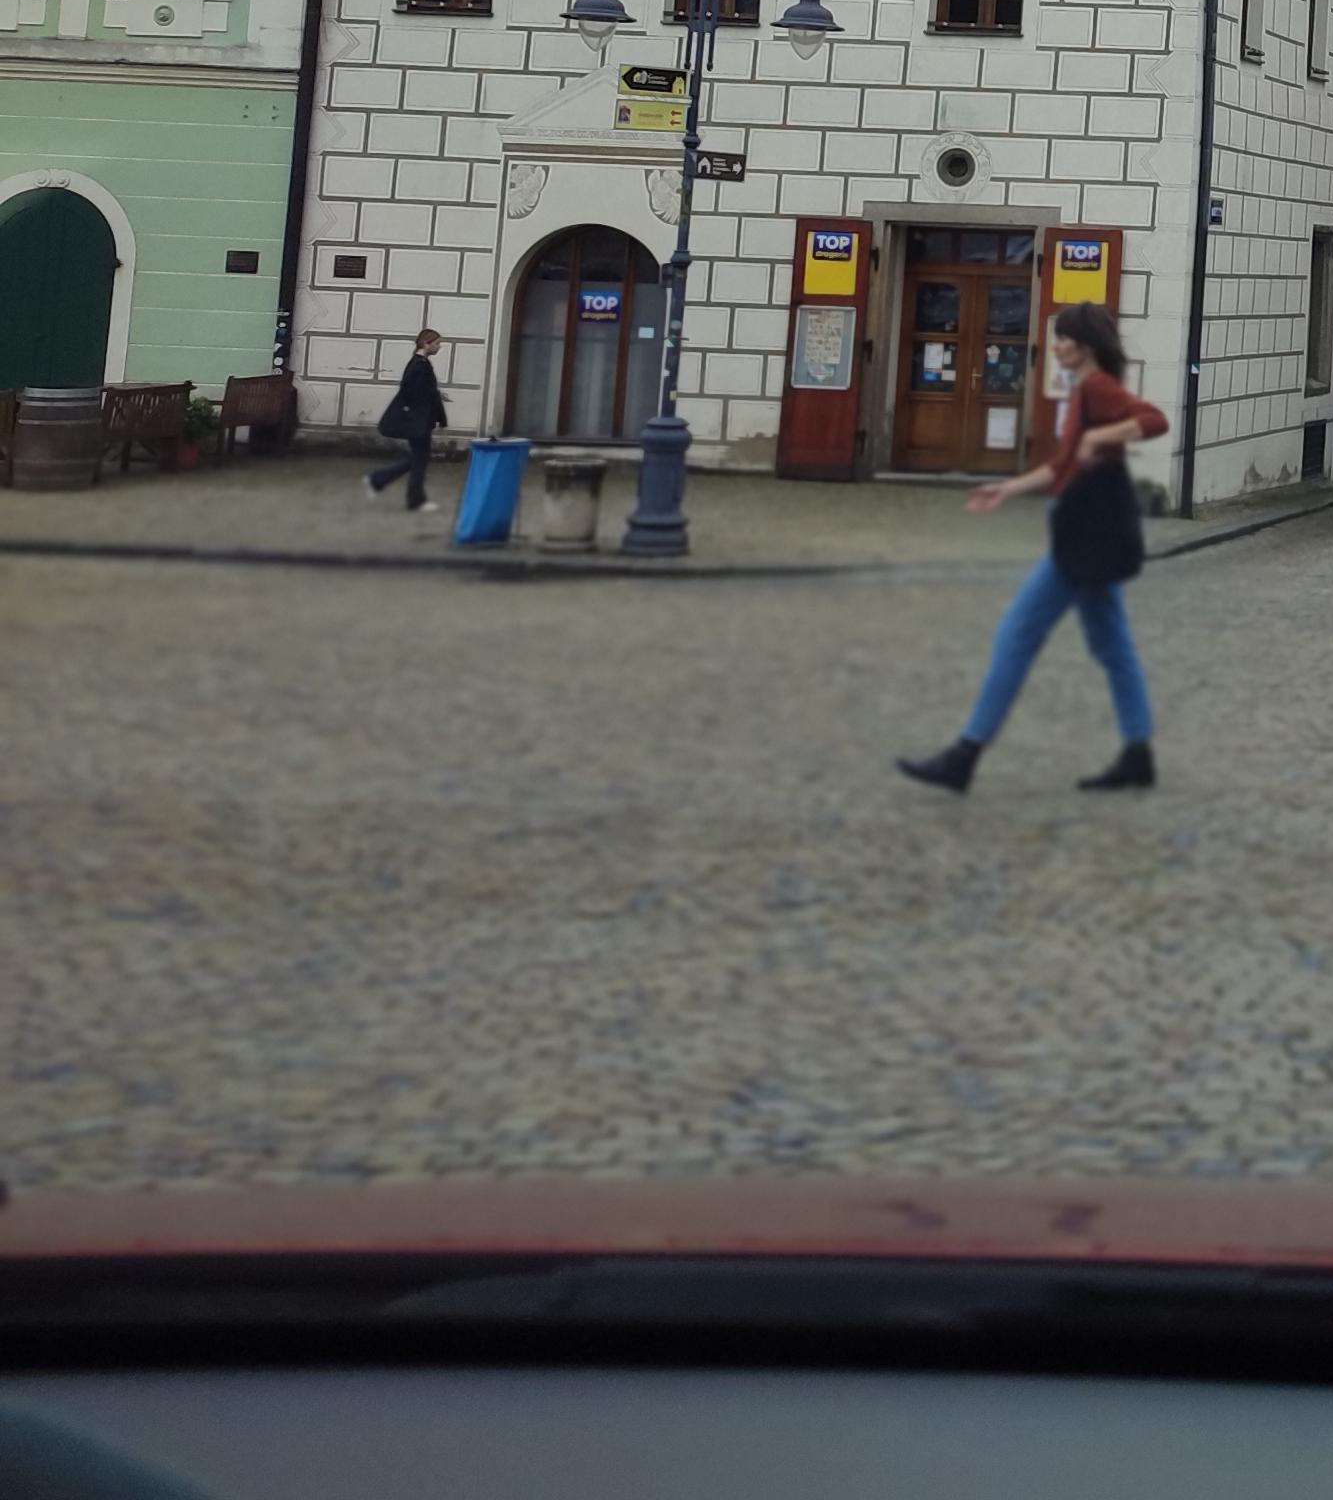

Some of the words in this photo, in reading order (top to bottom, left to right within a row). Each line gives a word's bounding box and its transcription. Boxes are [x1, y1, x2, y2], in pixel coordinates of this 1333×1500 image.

[816, 234, 850, 250] TOP
[1064, 244, 1099, 260] TOP
[582, 295, 619, 310] TOP
